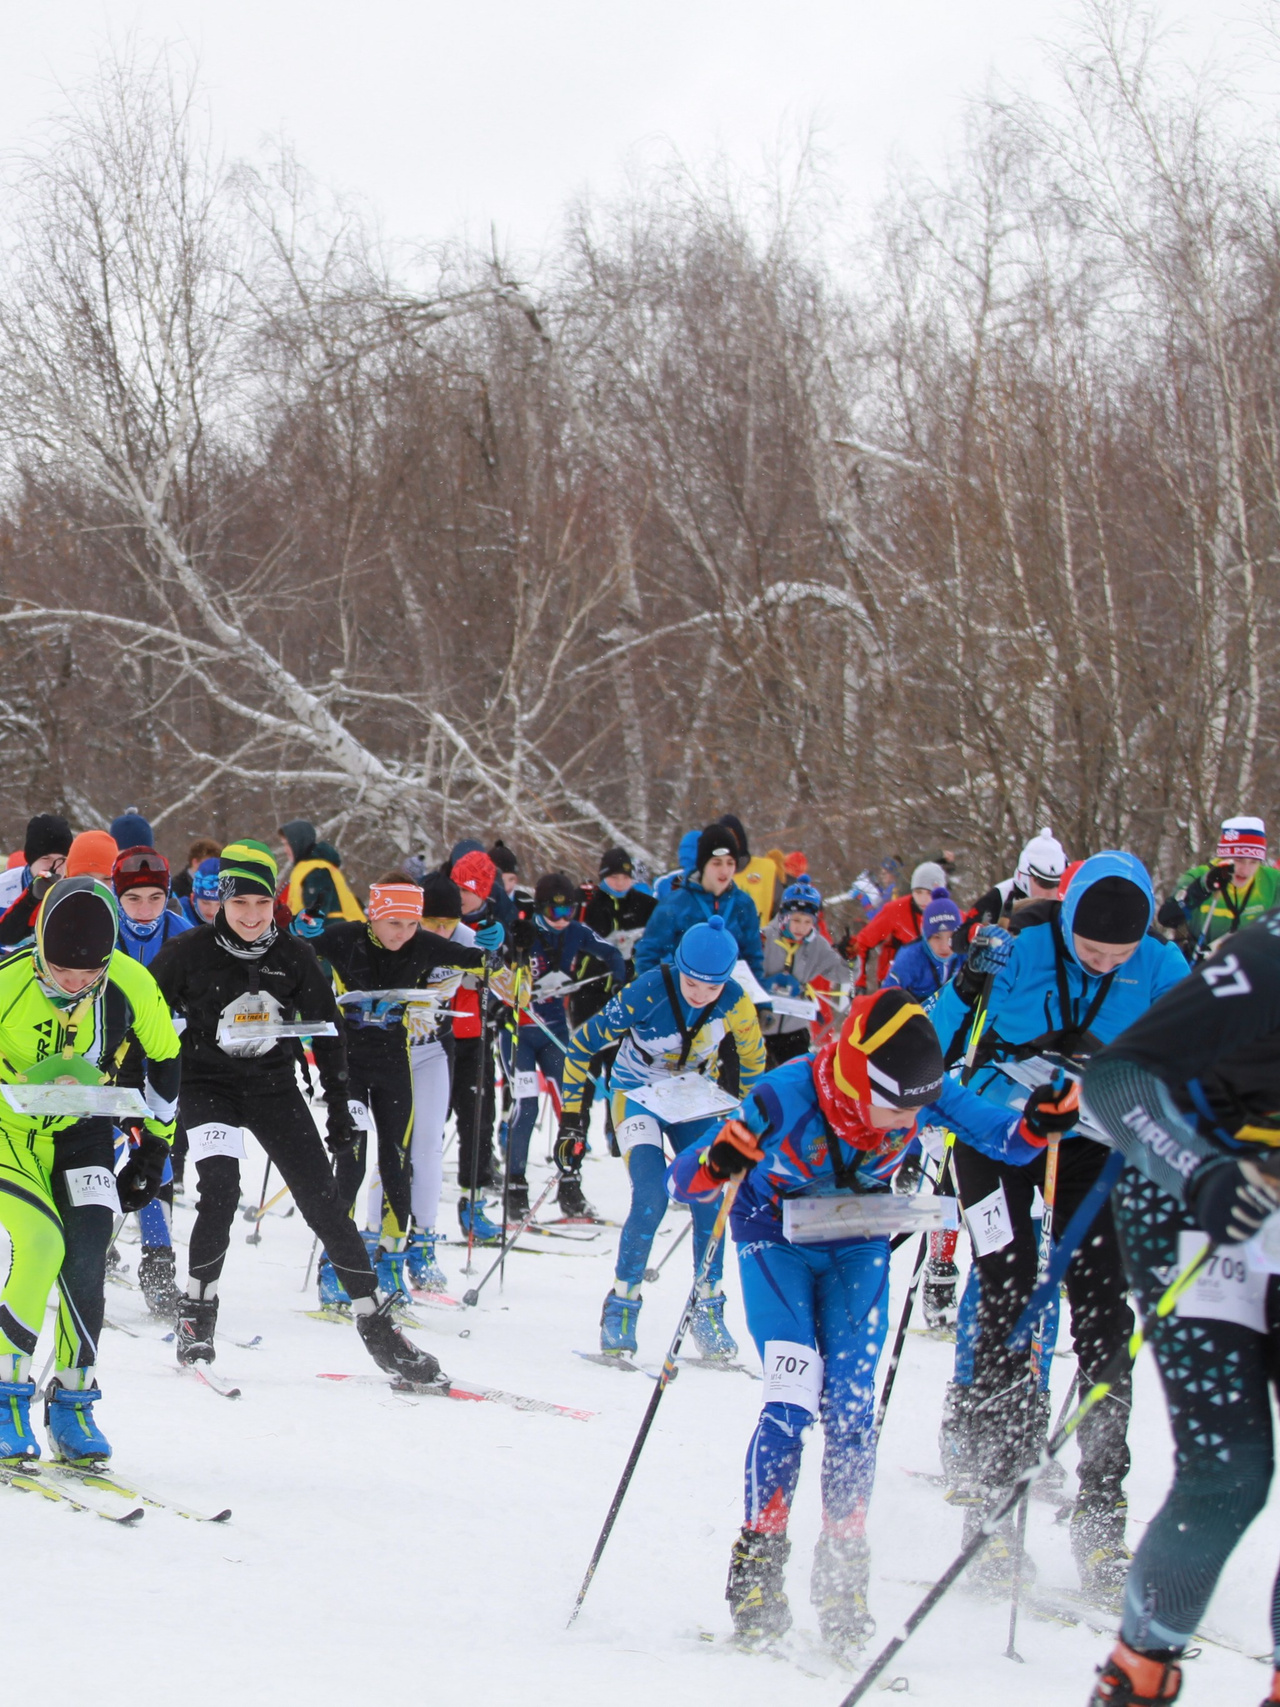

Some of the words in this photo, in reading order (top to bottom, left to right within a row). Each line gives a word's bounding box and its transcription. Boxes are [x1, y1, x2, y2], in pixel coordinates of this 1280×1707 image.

[929, 914, 956, 924] RUSSIA
[1200, 953, 1251, 998] 27
[518, 1077, 533, 1085] 764
[350, 1106, 363, 1116] 46
[624, 1121, 646, 1134] 735
[204, 1130, 227, 1141] 727
[1122, 1104, 1200, 1179] IMPULSE
[83, 1174, 112, 1189] 718
[1209, 1255, 1247, 1284] 709
[775, 1355, 809, 1376] 707
